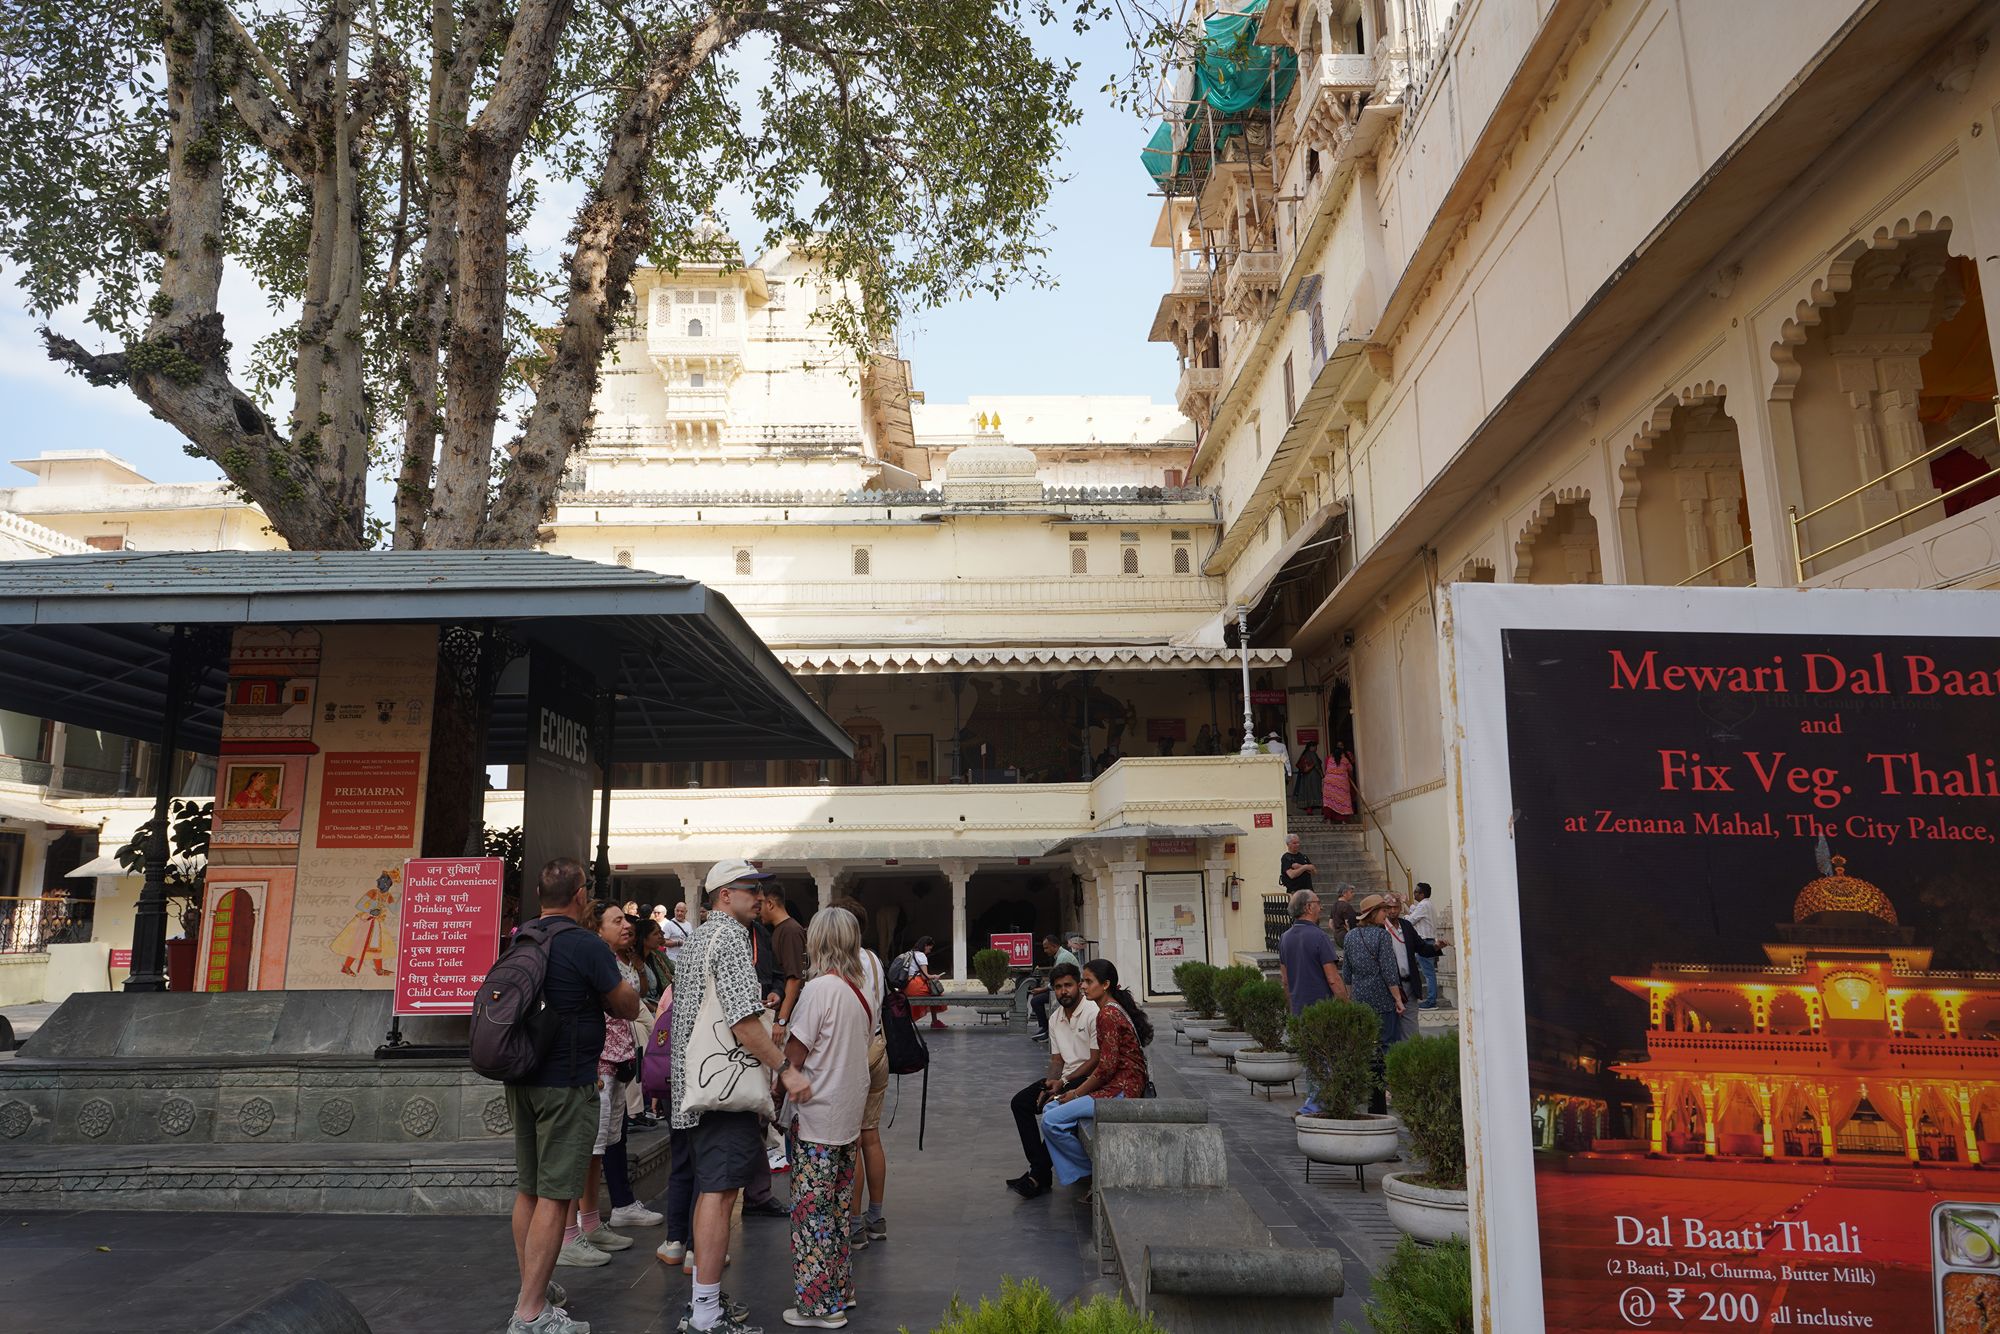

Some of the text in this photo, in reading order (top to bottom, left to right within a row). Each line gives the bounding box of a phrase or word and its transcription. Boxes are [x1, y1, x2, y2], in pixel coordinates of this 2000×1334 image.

[1608, 649, 1788, 692] Mewari
[1802, 652, 1891, 695] Dal
[1801, 713, 1843, 735] and
[540, 706, 587, 765] ECHOES
[1657, 749, 2000, 809] Fix Veg. Thali
[335, 787, 405, 796] PREMARPAN
[1564, 810, 1995, 846] at Zenana Mahal, The City Palace,
[427, 863, 481, 877] जन सुविधाएँ
[409, 877, 498, 887] Public Convenience
[414, 892, 469, 903] पीने का पानी
[413, 904, 481, 916] Drinking Water
[412, 919, 472, 930] महिला प्रसाधन
[411, 931, 468, 941] Ladies Toilet
[436, 947, 465, 955] प्रसाधन
[409, 958, 463, 968] Gents Toilet
[408, 974, 428, 985] शिशु
[433, 973, 466, 983] देखभाल
[407, 988, 432, 997] Child
[434, 988, 454, 997] Care
[1614, 1215, 1862, 1254] Dal Baati Thali
[1607, 1258, 1876, 1285] (2 Baati, Dal, Churma, Butter Milk)
[1619, 1286, 1874, 1328] @ ₹ 200 all inclusive
